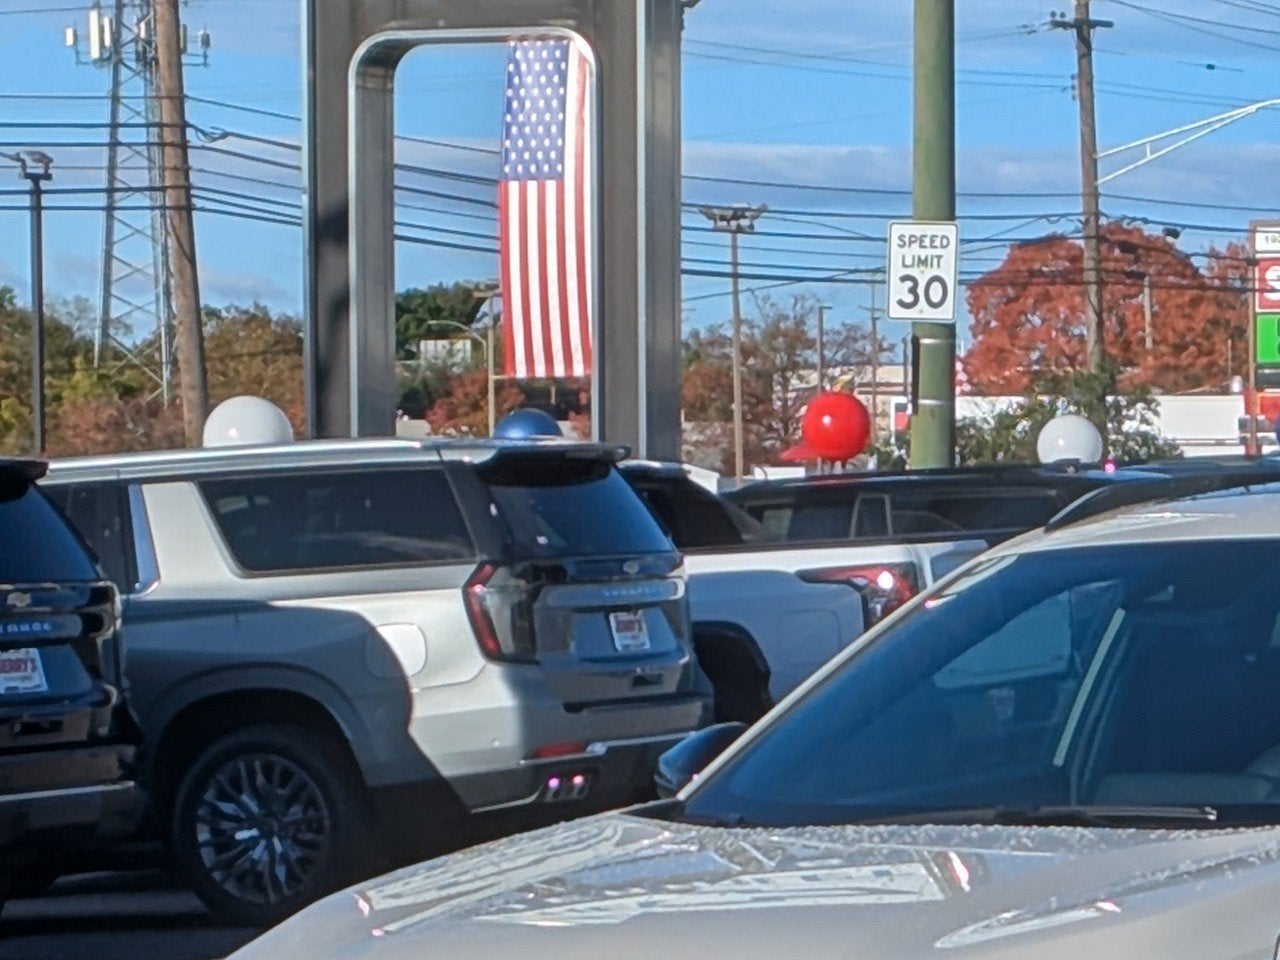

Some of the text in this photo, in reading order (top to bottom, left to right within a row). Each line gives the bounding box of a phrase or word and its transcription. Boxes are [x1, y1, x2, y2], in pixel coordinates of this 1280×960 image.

[897, 234, 950, 249] SPEED
[901, 254, 943, 268] LIMIT
[896, 274, 948, 309] 30
